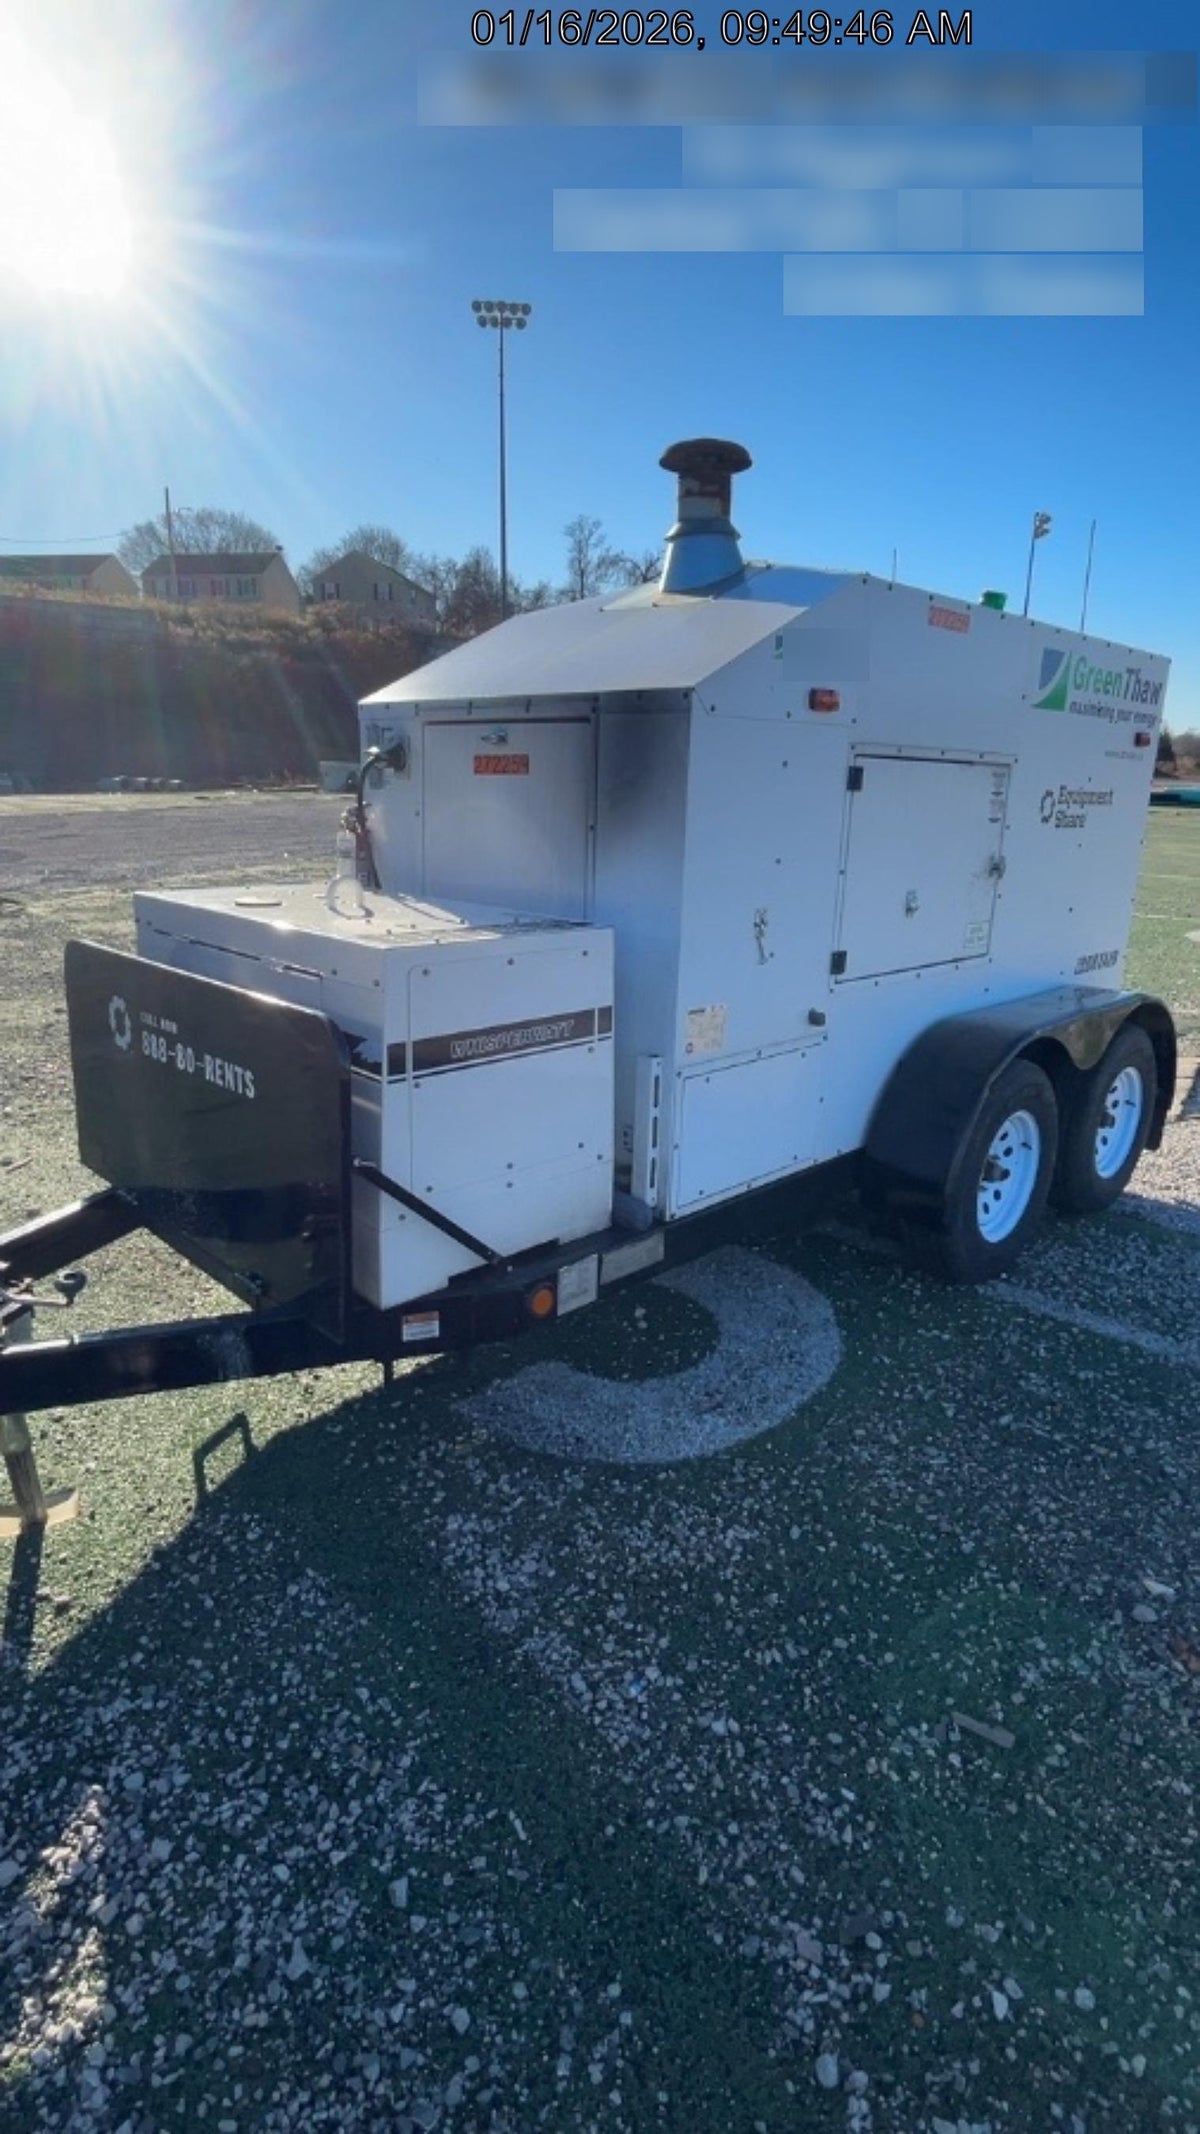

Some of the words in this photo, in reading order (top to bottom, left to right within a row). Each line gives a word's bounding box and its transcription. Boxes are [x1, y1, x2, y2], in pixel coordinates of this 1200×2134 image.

[1058, 785, 1113, 809] Equipment
[1055, 810, 1086, 828] Share
[141, 1030, 255, 1099] 888-80-RENTS
